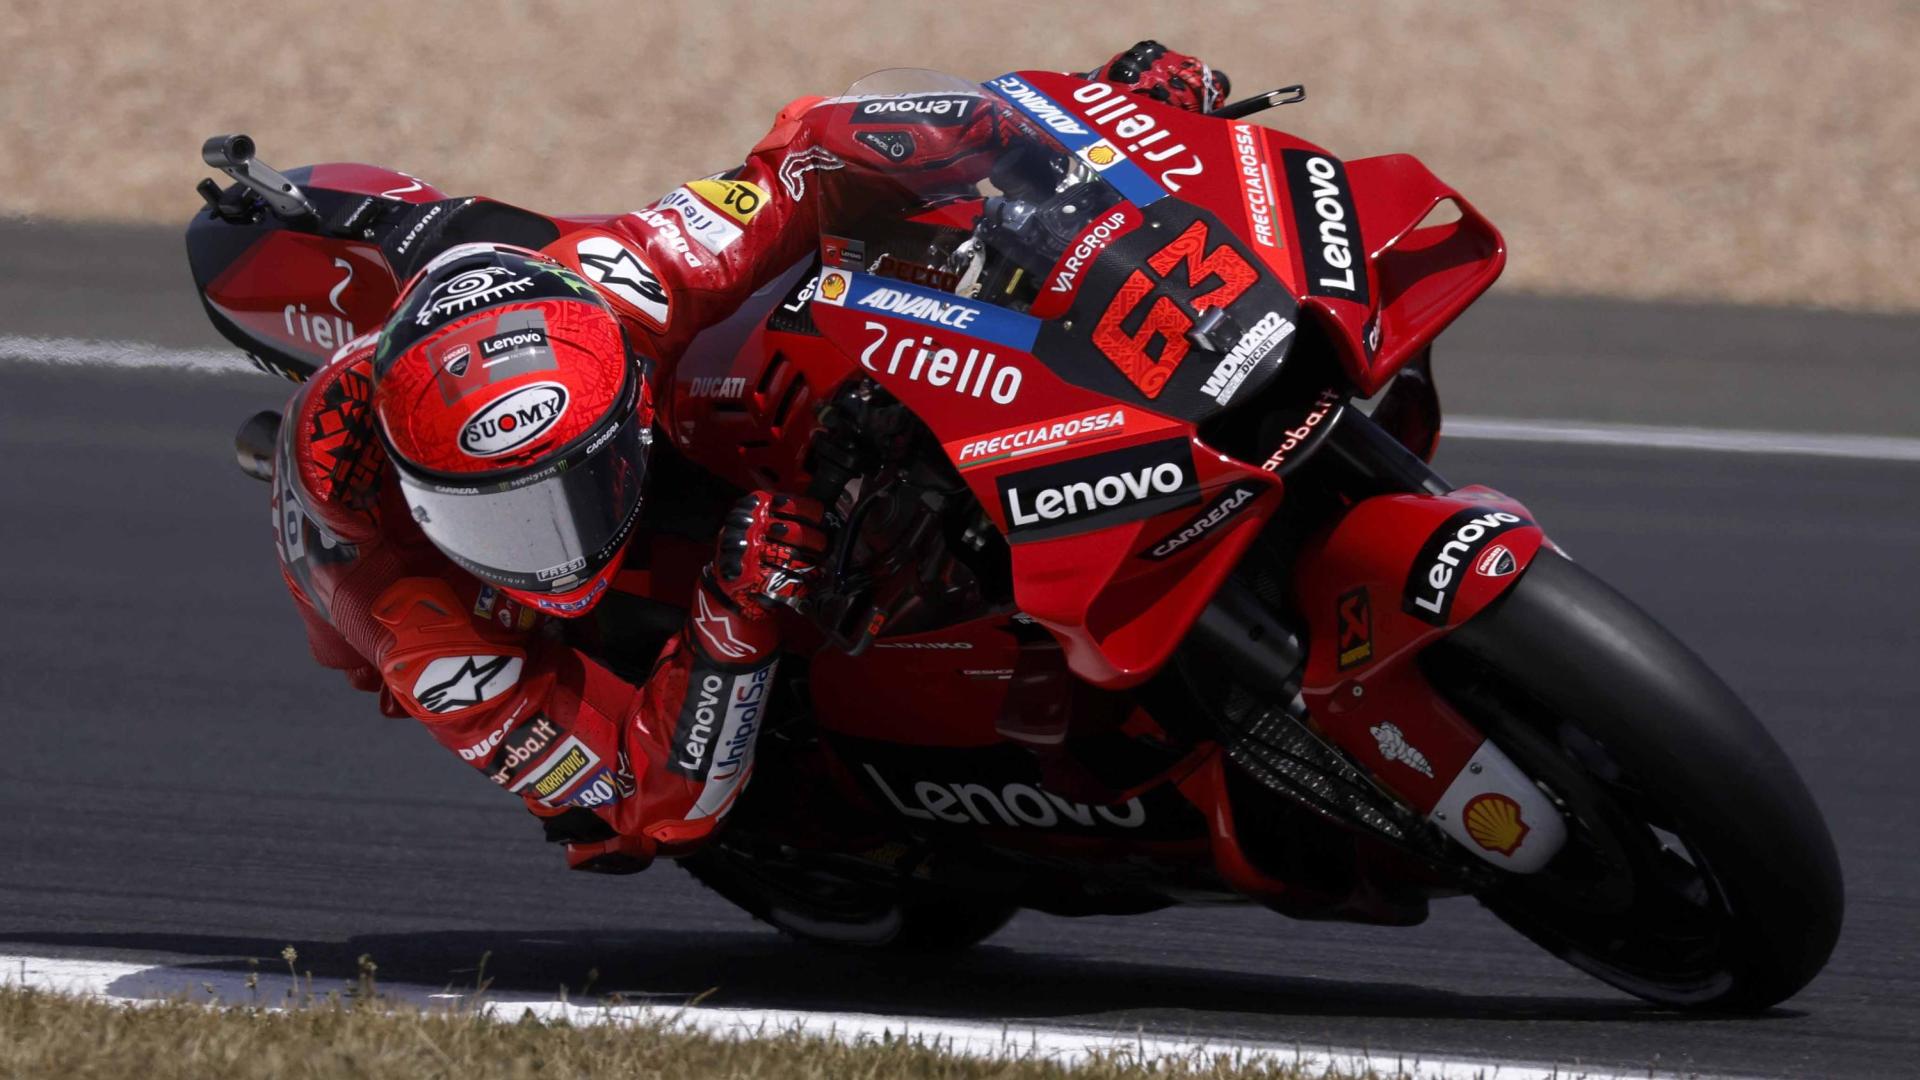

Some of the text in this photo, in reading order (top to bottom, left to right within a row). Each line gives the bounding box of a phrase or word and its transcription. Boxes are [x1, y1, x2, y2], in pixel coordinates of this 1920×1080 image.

[864, 99, 969, 118] Lenovo
[724, 184, 760, 215] Q1
[1234, 124, 1274, 247] FRECCIAROSSA
[397, 205, 441, 255] DUCATI
[630, 208, 702, 268] DUCATI
[1051, 212, 1125, 293] VARGROUP
[1305, 156, 1355, 292] Lenovo
[784, 276, 819, 313] Len
[857, 287, 980, 329] ADVANCE
[1092, 219, 1259, 399] 63
[284, 303, 355, 350] riell
[483, 332, 541, 353] Lenovo
[690, 377, 746, 398] DUCATI
[466, 397, 560, 442] SUOMY
[959, 410, 1125, 460] FRECCIAROSSA
[1261, 387, 1339, 472] aruba.it
[1008, 462, 1183, 526] Lenovo
[1153, 488, 1253, 557] CARRERA
[1415, 512, 1521, 614] Lenovo
[678, 674, 723, 771] Lenovo
[713, 665, 769, 780] UnipolSa
